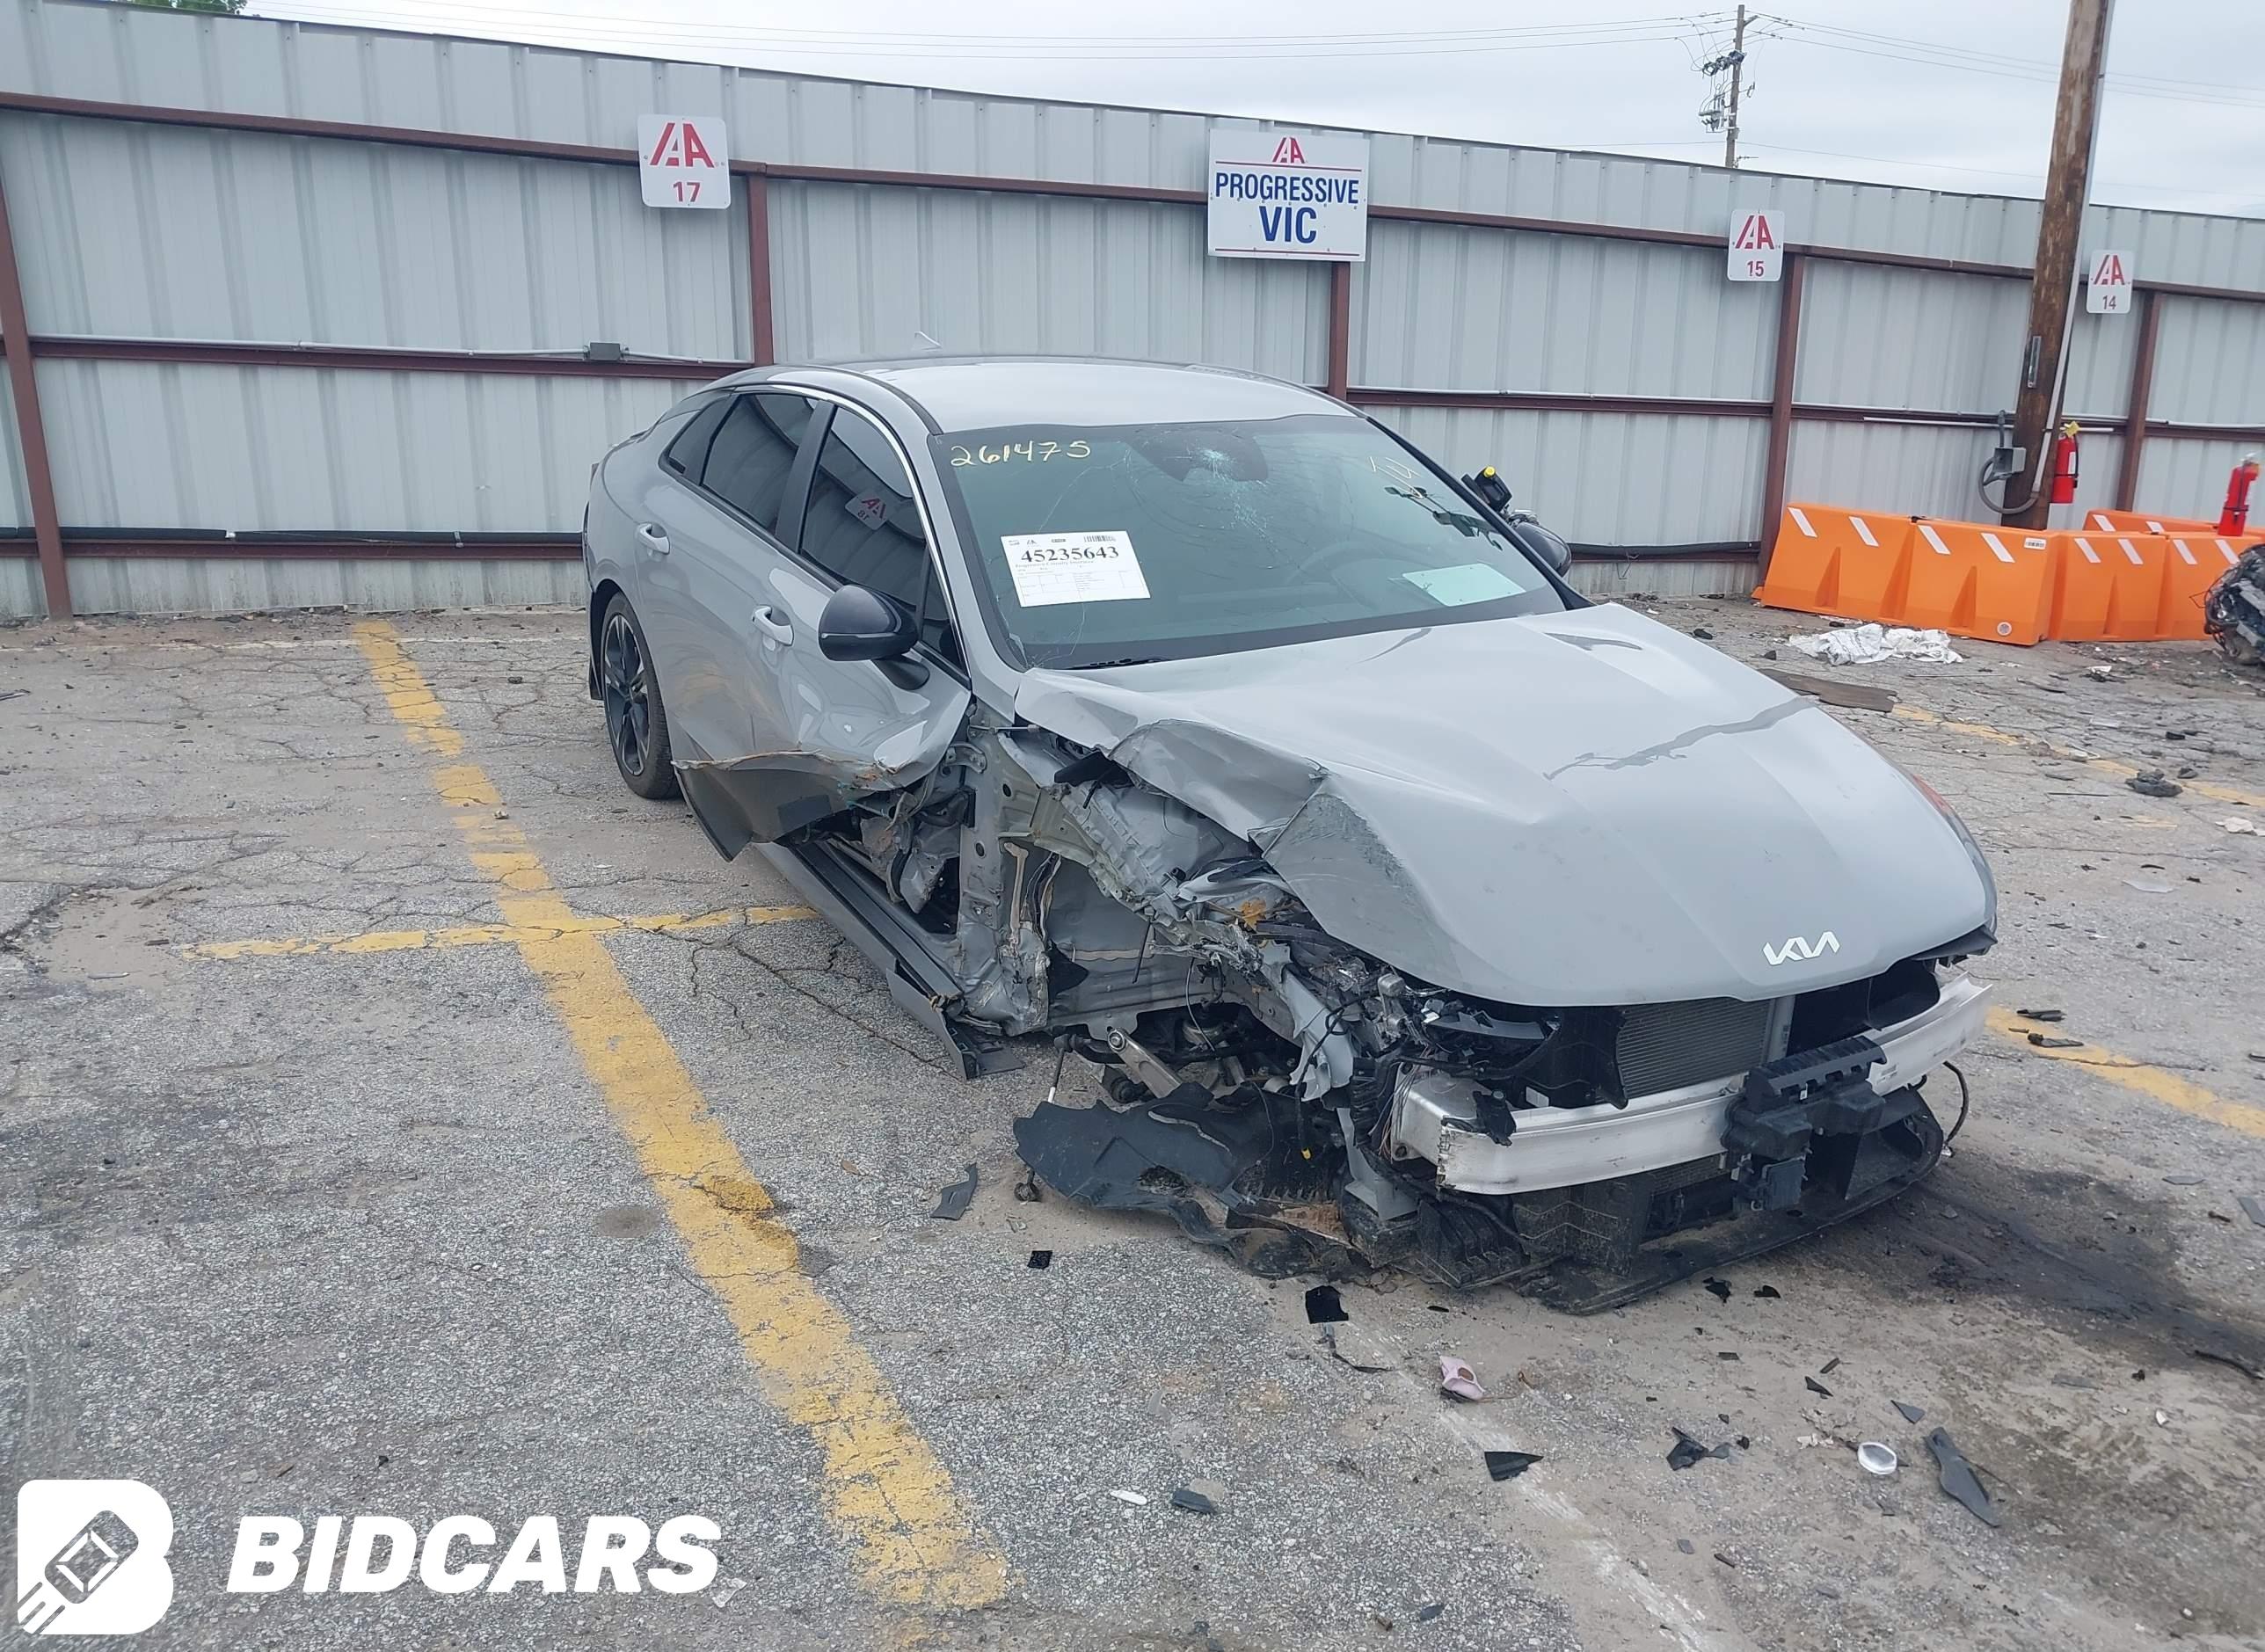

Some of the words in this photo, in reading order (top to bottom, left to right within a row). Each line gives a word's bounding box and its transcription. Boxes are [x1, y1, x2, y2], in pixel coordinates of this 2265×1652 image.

[673, 181, 701, 202] 17
[1215, 172, 1359, 204] PROGRESSIVE
[1259, 206, 1317, 244] VIC
[1747, 260, 1765, 277] 15
[2102, 295, 2116, 309] 14
[950, 440, 1091, 467] 261475
[1021, 546, 1119, 563] 45235643
[1762, 931, 1840, 965] KIA
